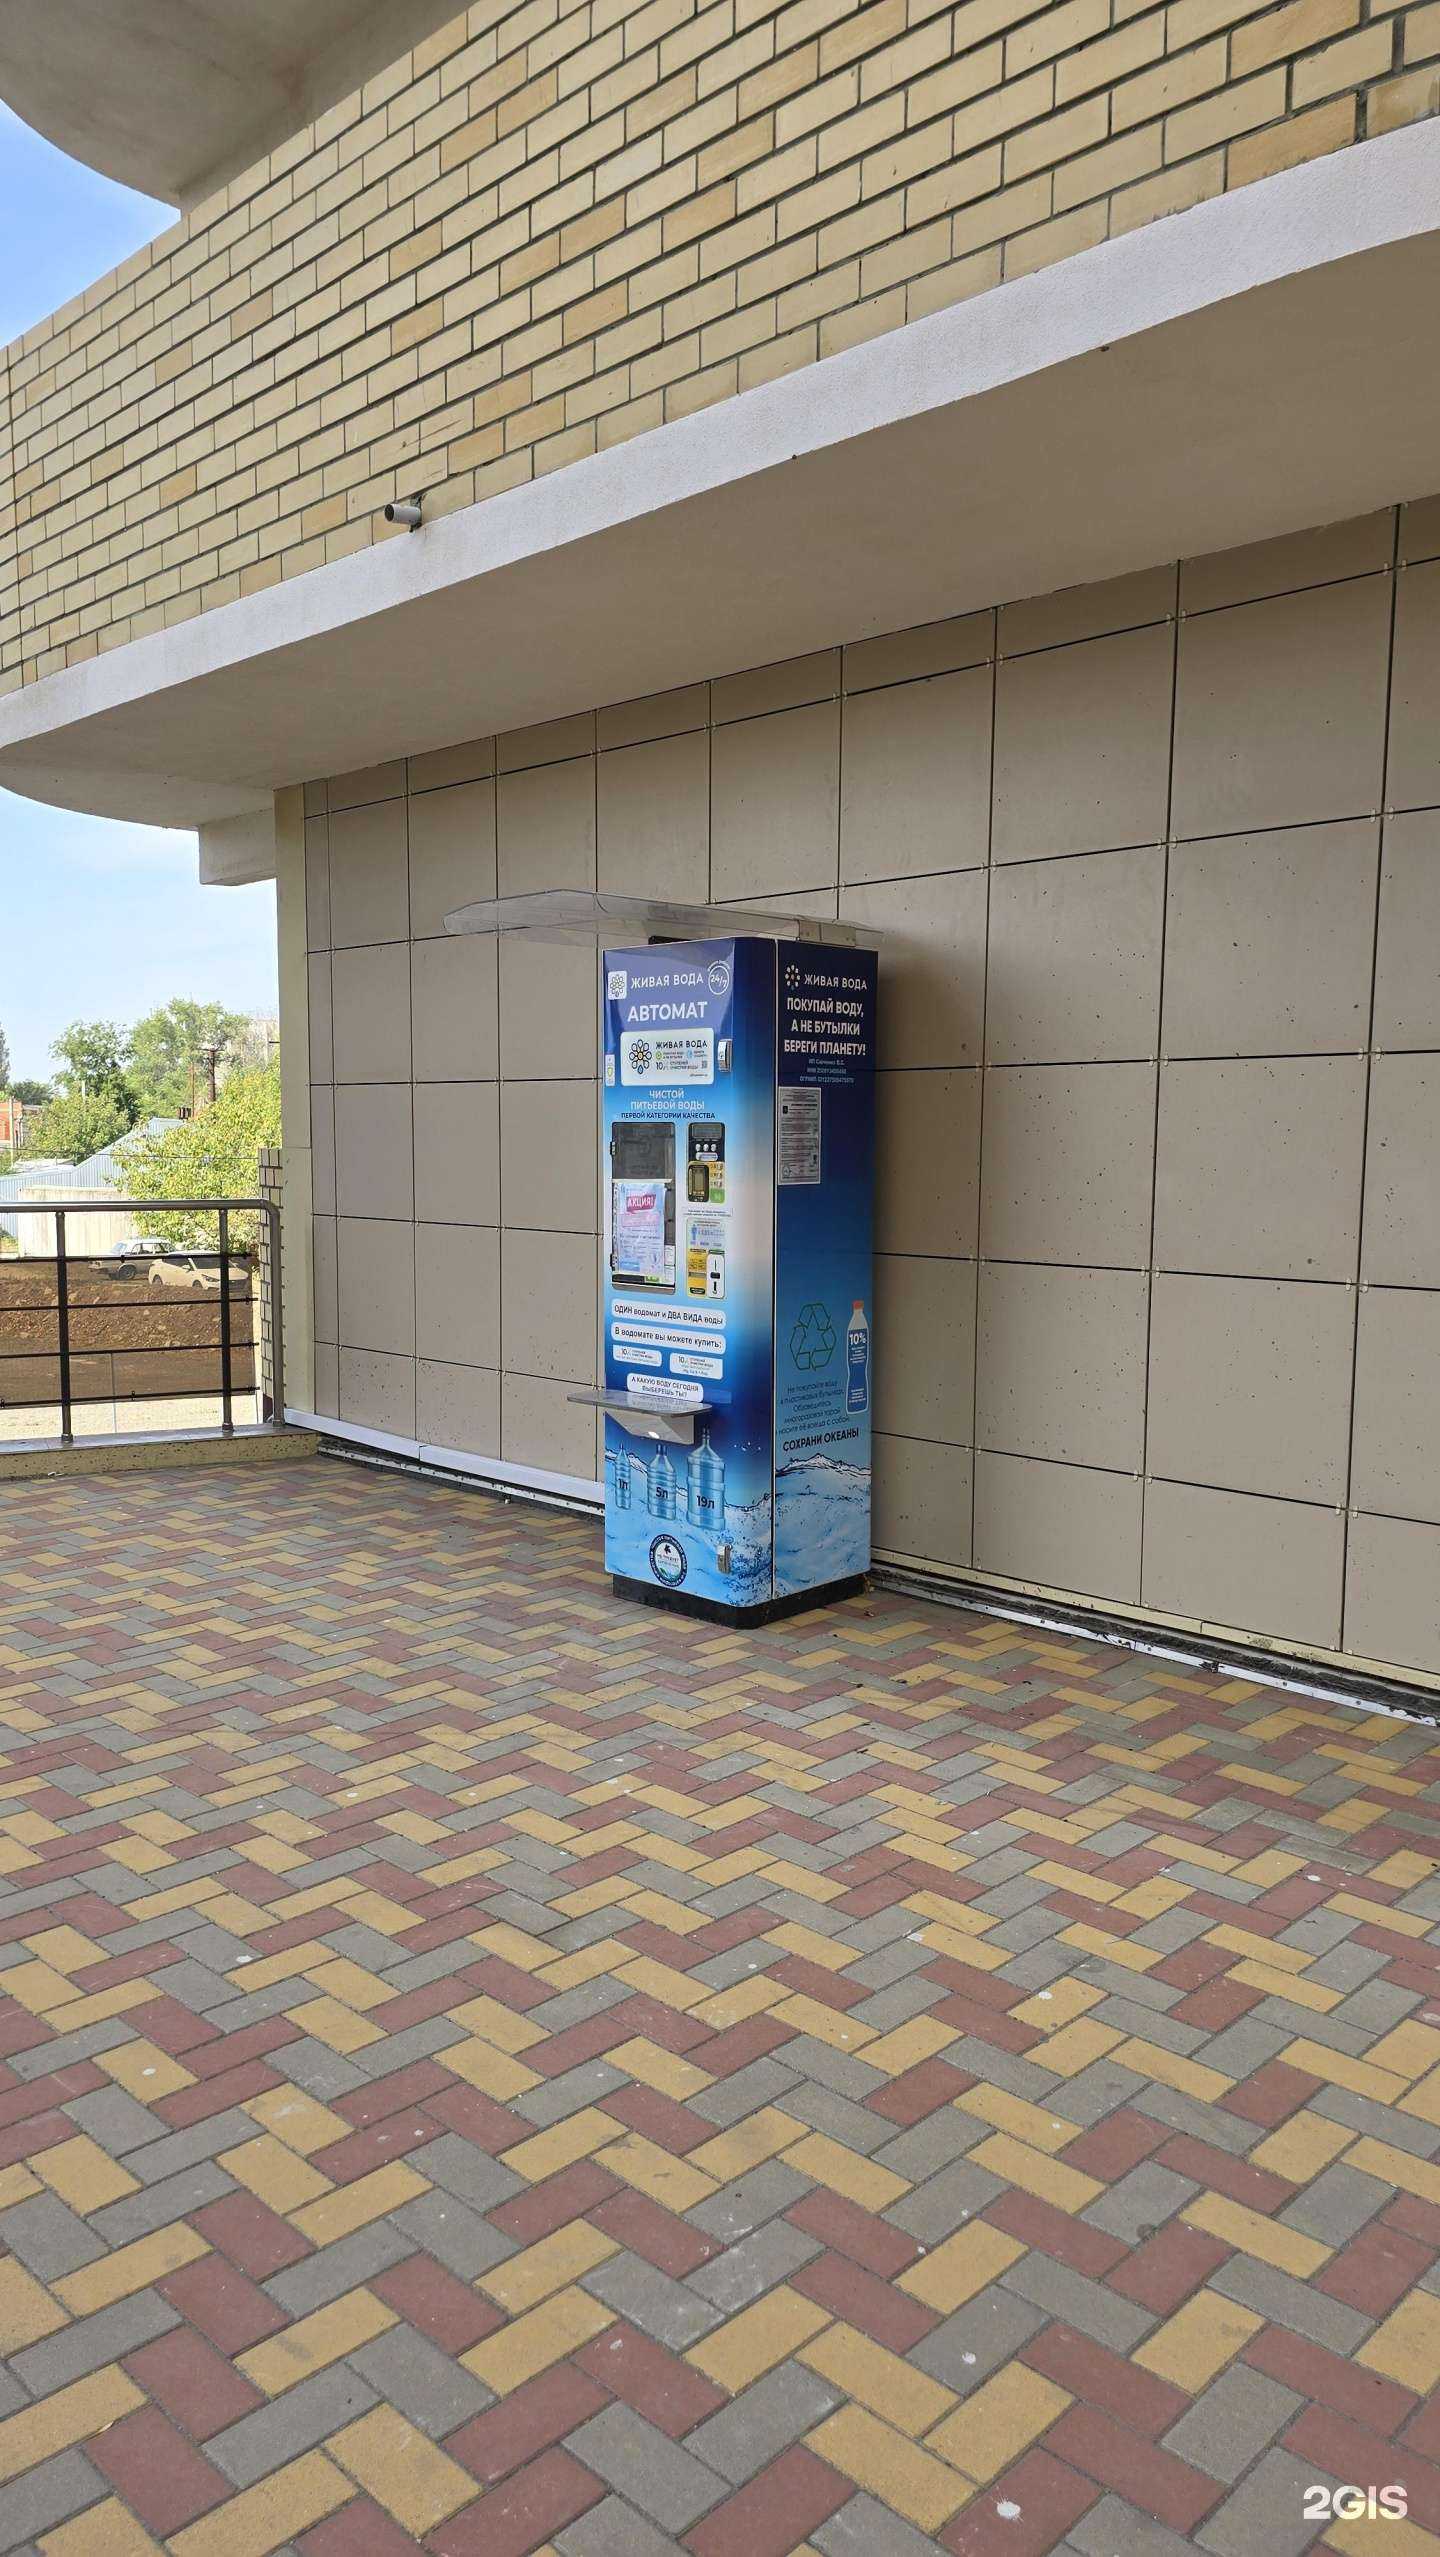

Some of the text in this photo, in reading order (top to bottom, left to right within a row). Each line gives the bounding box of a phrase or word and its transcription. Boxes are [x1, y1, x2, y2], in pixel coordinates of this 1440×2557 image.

[631, 973, 704, 989] ЖИВАЯ ВОДА
[804, 974, 867, 990] ЖИВАЯ ВОДА
[627, 1001, 708, 1022] АВТОМАТ
[787, 997, 864, 1017] ПОКУПАЙ ВОДУ,
[791, 1019, 860, 1035] А НЕ БУТЫЛКИ
[655, 1040, 708, 1049] ЖИВАЯ ВОДА
[784, 1040, 866, 1056] БЕРЕГИ ПЛАНЕТУ!
[649, 1088, 684, 1099] ЧИСТОЙ
[630, 1100, 705, 1110] ПИТЬЕВОЙ ВОДЫ
[621, 1111, 645, 1119] ПЕРВОЙ
[614, 1305, 632, 1314] ОДИН
[634, 1308, 660, 1317] водомат
[667, 1311, 681, 1320] ДВА
[683, 1312, 702, 1323] ВИДА
[704, 1316, 723, 1324] воды
[615, 1327, 620, 1335] В
[621, 1328, 654, 1338] водомате
[655, 1333, 666, 1341] вы
[667, 1335, 692, 1345] можете
[849, 1332, 866, 1345] 10%
[636, 1376, 655, 1385] КАКУЮ
[656, 1379, 671, 1388] ВОДУ
[672, 1381, 699, 1391] СЕГОДНЯ
[783, 1427, 859, 1452] СОХРАНИ ОКЕАНЫ
[618, 1478, 628, 1490] 1л
[655, 1487, 668, 1499] 5л
[696, 1495, 715, 1509] 19л
